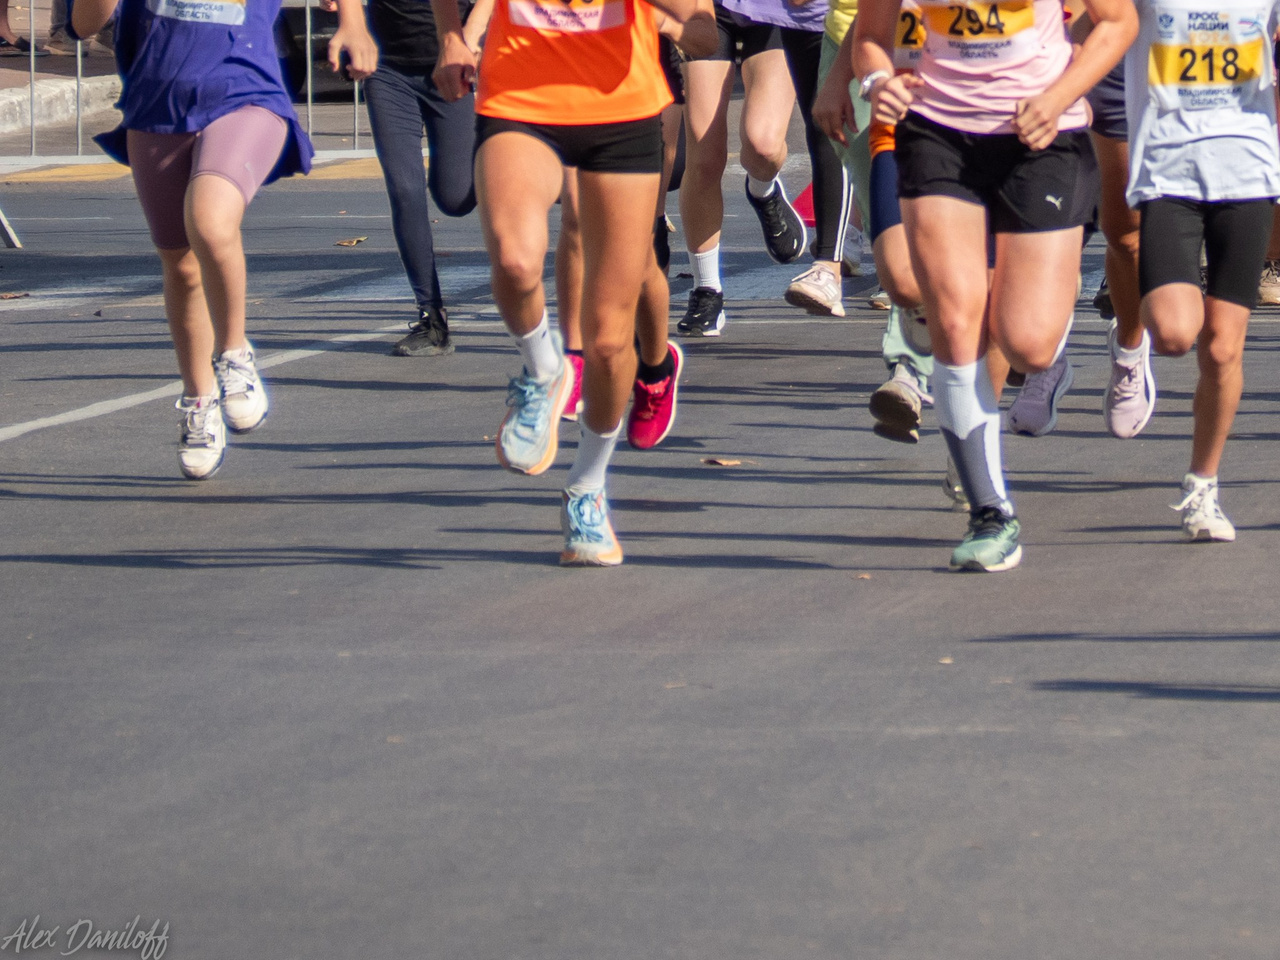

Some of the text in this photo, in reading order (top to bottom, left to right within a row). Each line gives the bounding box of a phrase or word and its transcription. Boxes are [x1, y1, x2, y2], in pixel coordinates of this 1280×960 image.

[948, 4, 1005, 35] 294
[1187, 22, 1229, 31] НАЦИИ
[1188, 12, 1218, 21] КРОСС
[1179, 48, 1239, 82] 218
